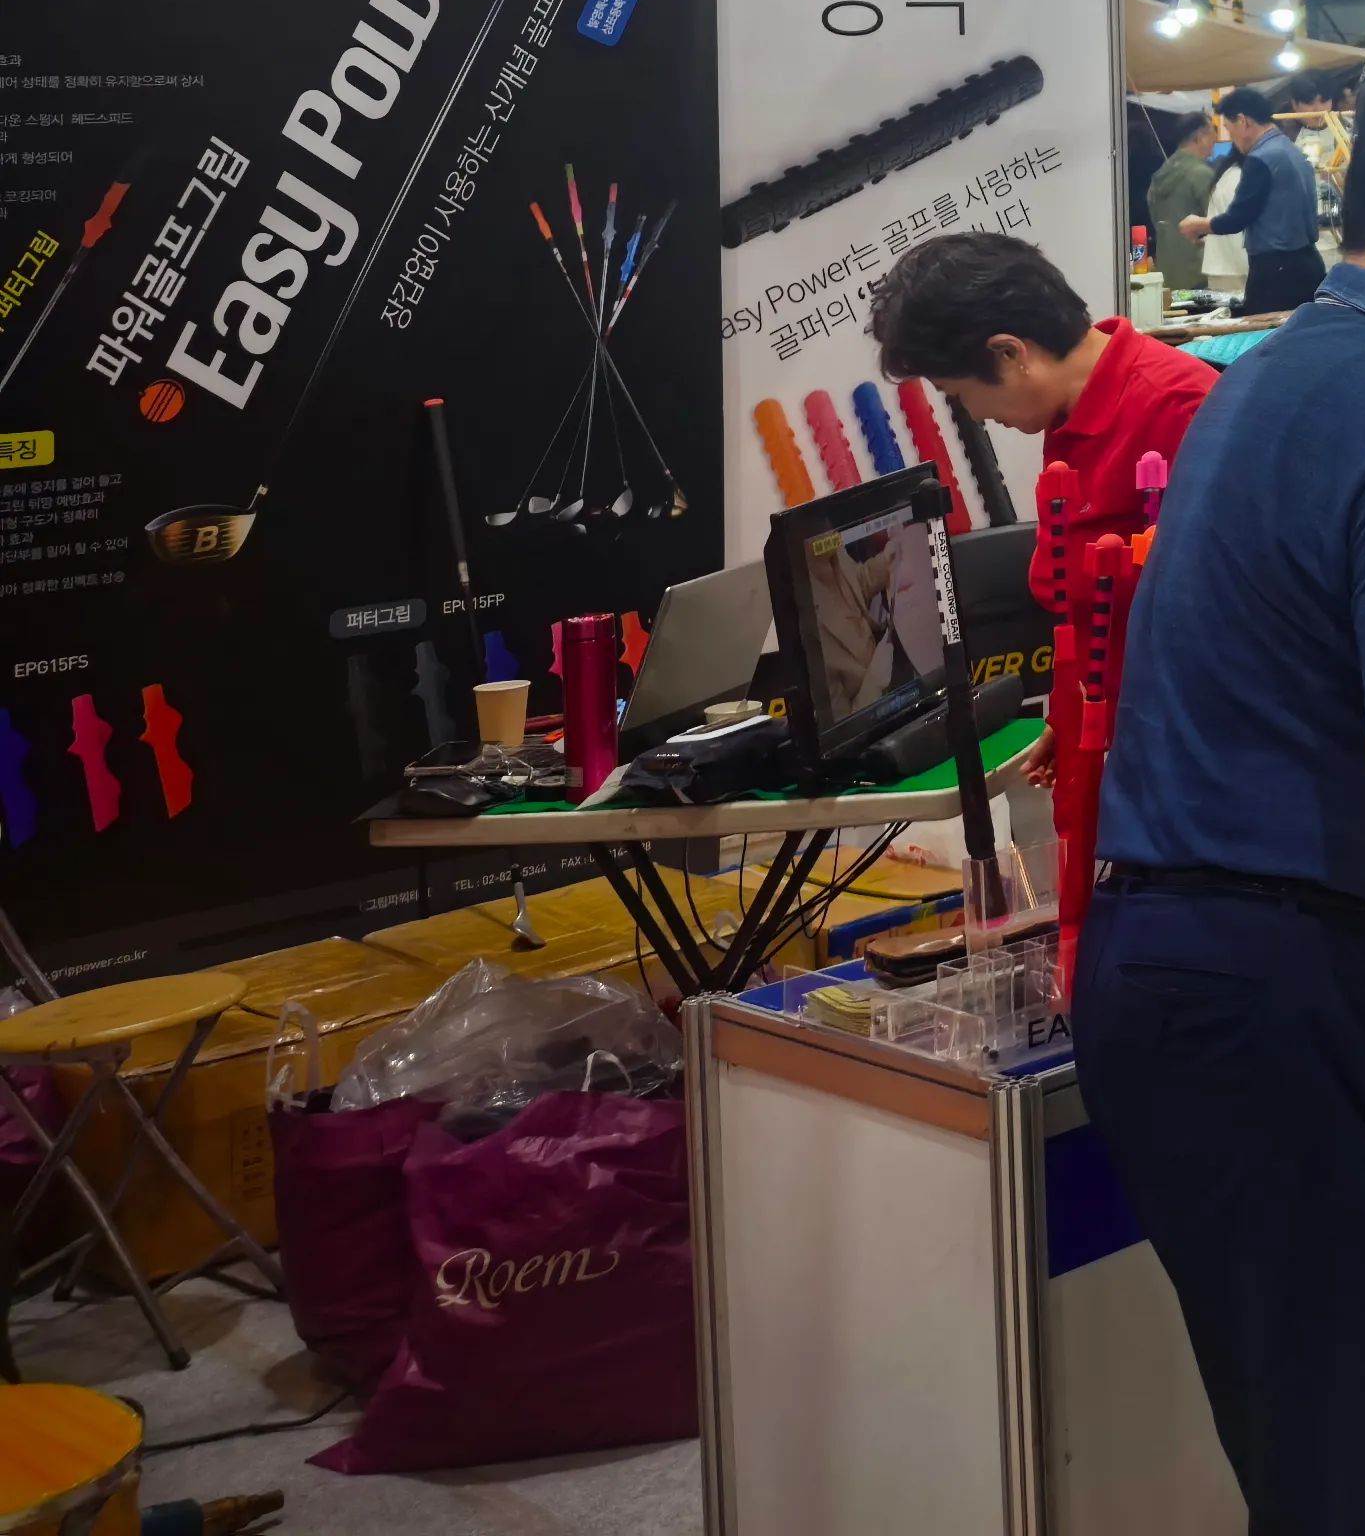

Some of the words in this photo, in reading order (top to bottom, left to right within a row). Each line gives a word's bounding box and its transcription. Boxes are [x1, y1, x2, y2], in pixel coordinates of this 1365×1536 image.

[380, 224, 451, 330] 장갑없이
[437, 128, 500, 230] 사용하는
[484, 41, 539, 124] 신개념
[86, 136, 250, 387] 파워골프그립
[722, 300, 763, 341] asy
[765, 243, 881, 314] Power는
[882, 193, 962, 256] 골프를
[965, 147, 1063, 208] 사랑하는
[0, 228, 60, 339] 퍼터그립
[166, 170, 361, 410] Easy
[769, 293, 857, 362] 골퍼의
[937, 531, 949, 558] EASY
[346, 603, 413, 631] 퍼터그립
[942, 562, 957, 615] COCKING
[950, 618, 960, 642] BAR
[13, 653, 90, 679] EPG15FS
[453, 879, 474, 891] TEL
[482, 863, 547, 887] 02-82-5344
[561, 856, 581, 869] FAX
[14, 948, 149, 988] w.grippower.co.kr
[435, 1247, 620, 1310] Roem
